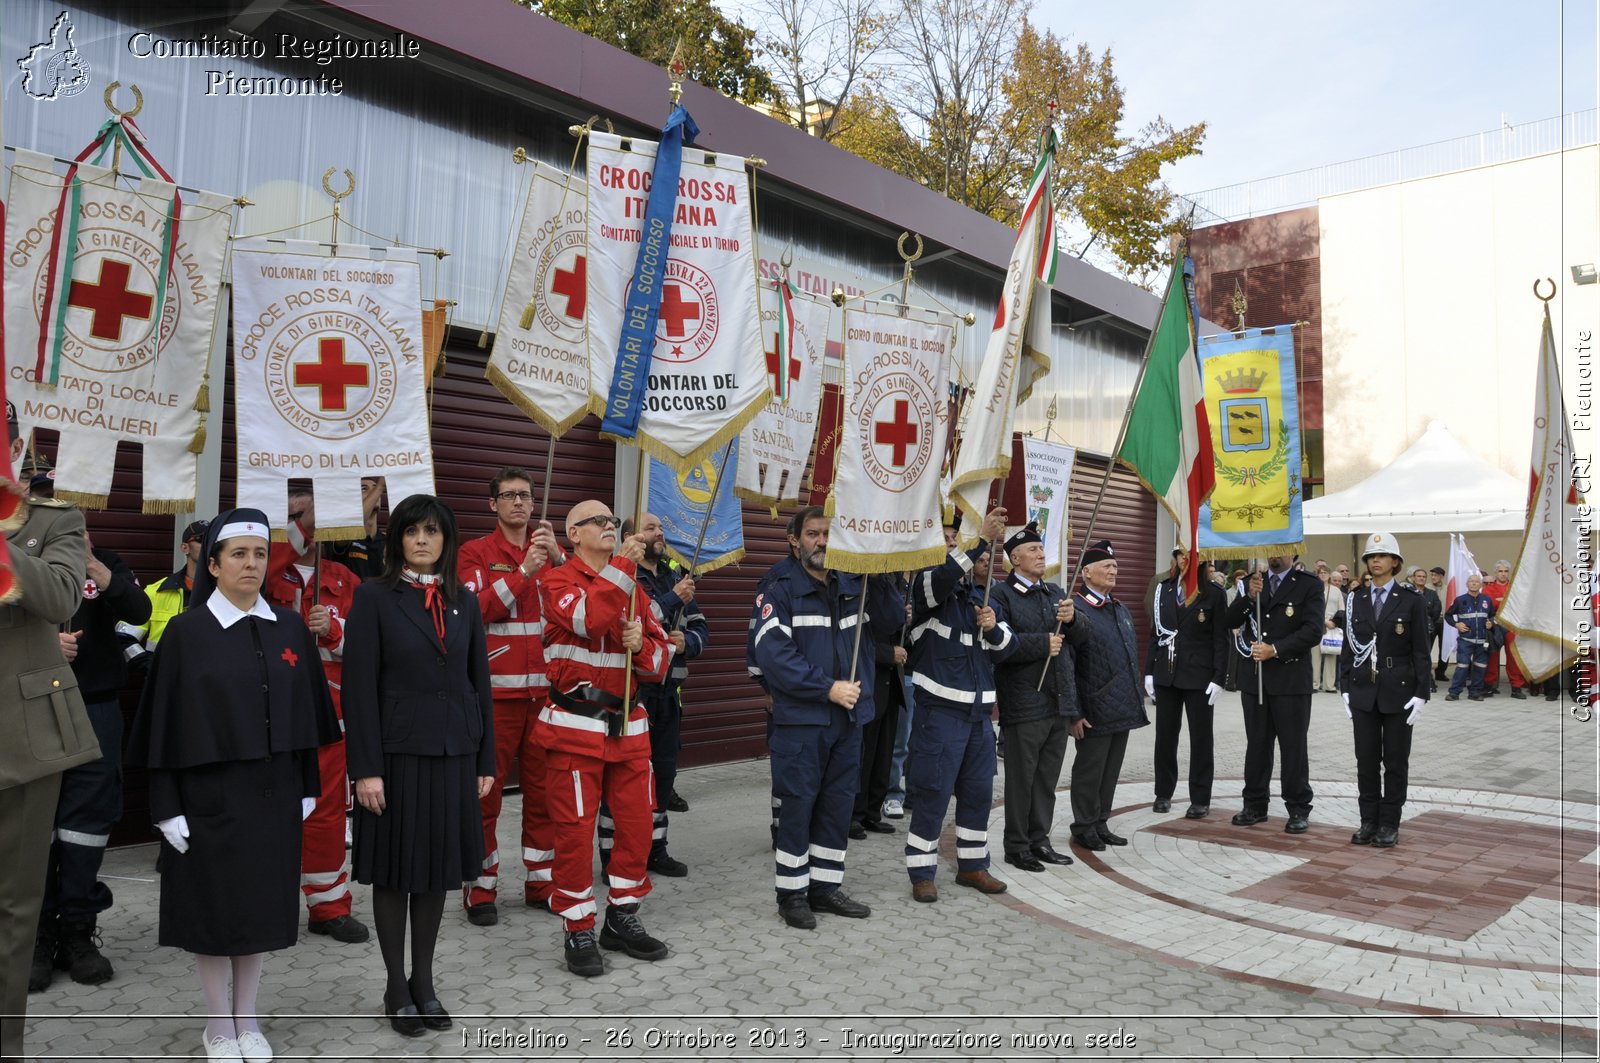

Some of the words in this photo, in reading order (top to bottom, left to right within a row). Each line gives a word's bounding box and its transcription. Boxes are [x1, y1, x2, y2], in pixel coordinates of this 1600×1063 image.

[600, 165, 653, 193] CROC
[624, 196, 717, 227] ITANA
[528, 215, 563, 259] CROCE
[566, 209, 588, 226] ROS
[553, 238, 564, 252] DI
[600, 224, 641, 244] COMITATO
[668, 234, 699, 249] NCIALE
[702, 236, 712, 248] DI
[714, 236, 740, 252] TORINO
[92, 233, 161, 270] GINEVRA
[152, 218, 209, 305] ILIANA
[637, 217, 664, 295] SOCCORSO
[260, 265, 317, 281] VOLONTARI
[323, 270, 342, 283] DEL
[347, 271, 394, 285] SOCCORSO
[695, 275, 709, 291] 22
[629, 303, 650, 330] DEL
[702, 289, 716, 332] AGOSTO
[241, 302, 285, 361] CROCE
[285, 288, 353, 311] ROSSA
[357, 294, 418, 366] ITALIANA
[288, 325, 304, 341] DI
[308, 314, 370, 341] GINEVRA
[760, 310, 780, 322] ROSS
[794, 319, 819, 366] TALIANA
[370, 340, 387, 358] 22
[694, 331, 712, 352] 1864
[269, 341, 320, 432] CONVENZIONE
[373, 361, 394, 411] AGOSTO
[507, 359, 589, 391] CARMAGNO
[611, 336, 641, 419] VOLONTARI
[645, 375, 707, 391] ONTARI
[713, 373, 739, 389] DEL
[985, 332, 1019, 413] ITALIANA
[10, 366, 103, 395] COTATO
[111, 383, 179, 408] LOCALE
[849, 363, 874, 416] COCE
[913, 358, 949, 426] ITALINA
[872, 386, 883, 400] DI
[87, 396, 104, 410] DI
[641, 394, 727, 412] SOCCORSO
[918, 402, 931, 417] 22
[23, 400, 158, 437] MONCALIERI
[348, 406, 379, 433] 1864
[820, 425, 844, 456] DONATOR
[918, 421, 932, 465] AGOSTO
[249, 451, 313, 469] GRUPPO
[320, 454, 335, 468] DI
[340, 453, 361, 468] LA
[365, 451, 424, 469] LOGGIA
[1026, 451, 1067, 466] ASSOCIAZIONE
[1030, 463, 1058, 476] POLESANI
[1026, 473, 1037, 481] NEL
[1042, 475, 1063, 487] MONDO
[839, 515, 920, 533] CASTAGNOLE
